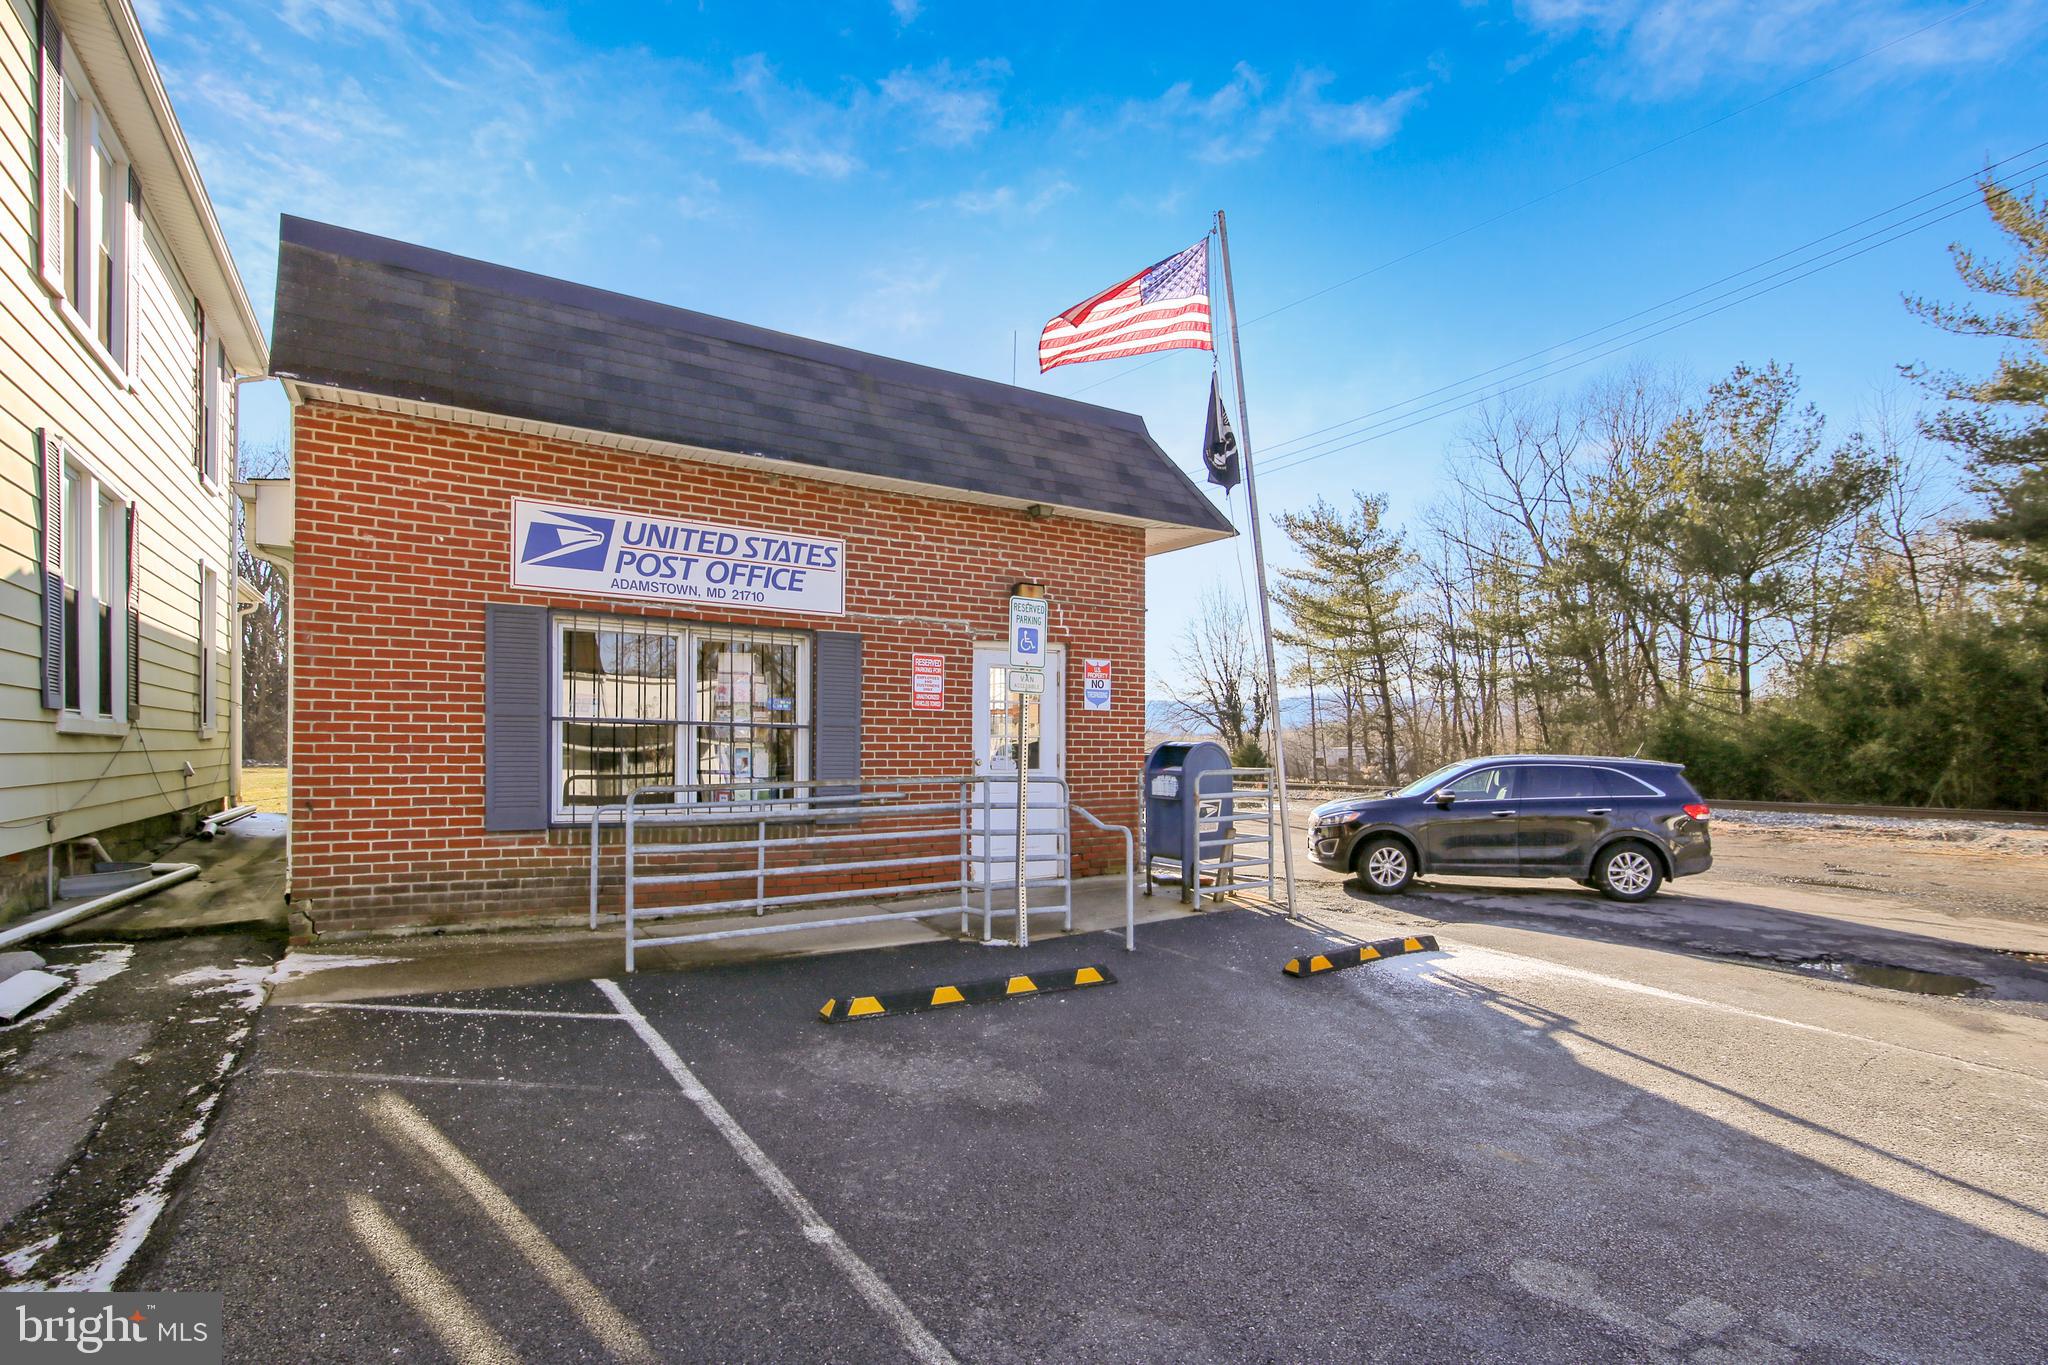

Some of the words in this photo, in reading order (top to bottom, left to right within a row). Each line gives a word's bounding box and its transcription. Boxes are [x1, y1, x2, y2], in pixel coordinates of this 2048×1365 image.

[622, 521, 738, 556] UNITED
[742, 536, 838, 568] STATES
[615, 550, 699, 580] POST
[705, 560, 806, 592] OFFICE
[610, 578, 701, 597] ADAMSTOWN,
[706, 587, 726, 599] MD
[731, 589, 765, 603] 21710
[1013, 602, 1045, 615] RESERVED
[1016, 614, 1042, 626] PARKING
[1091, 679, 1105, 689] NO
